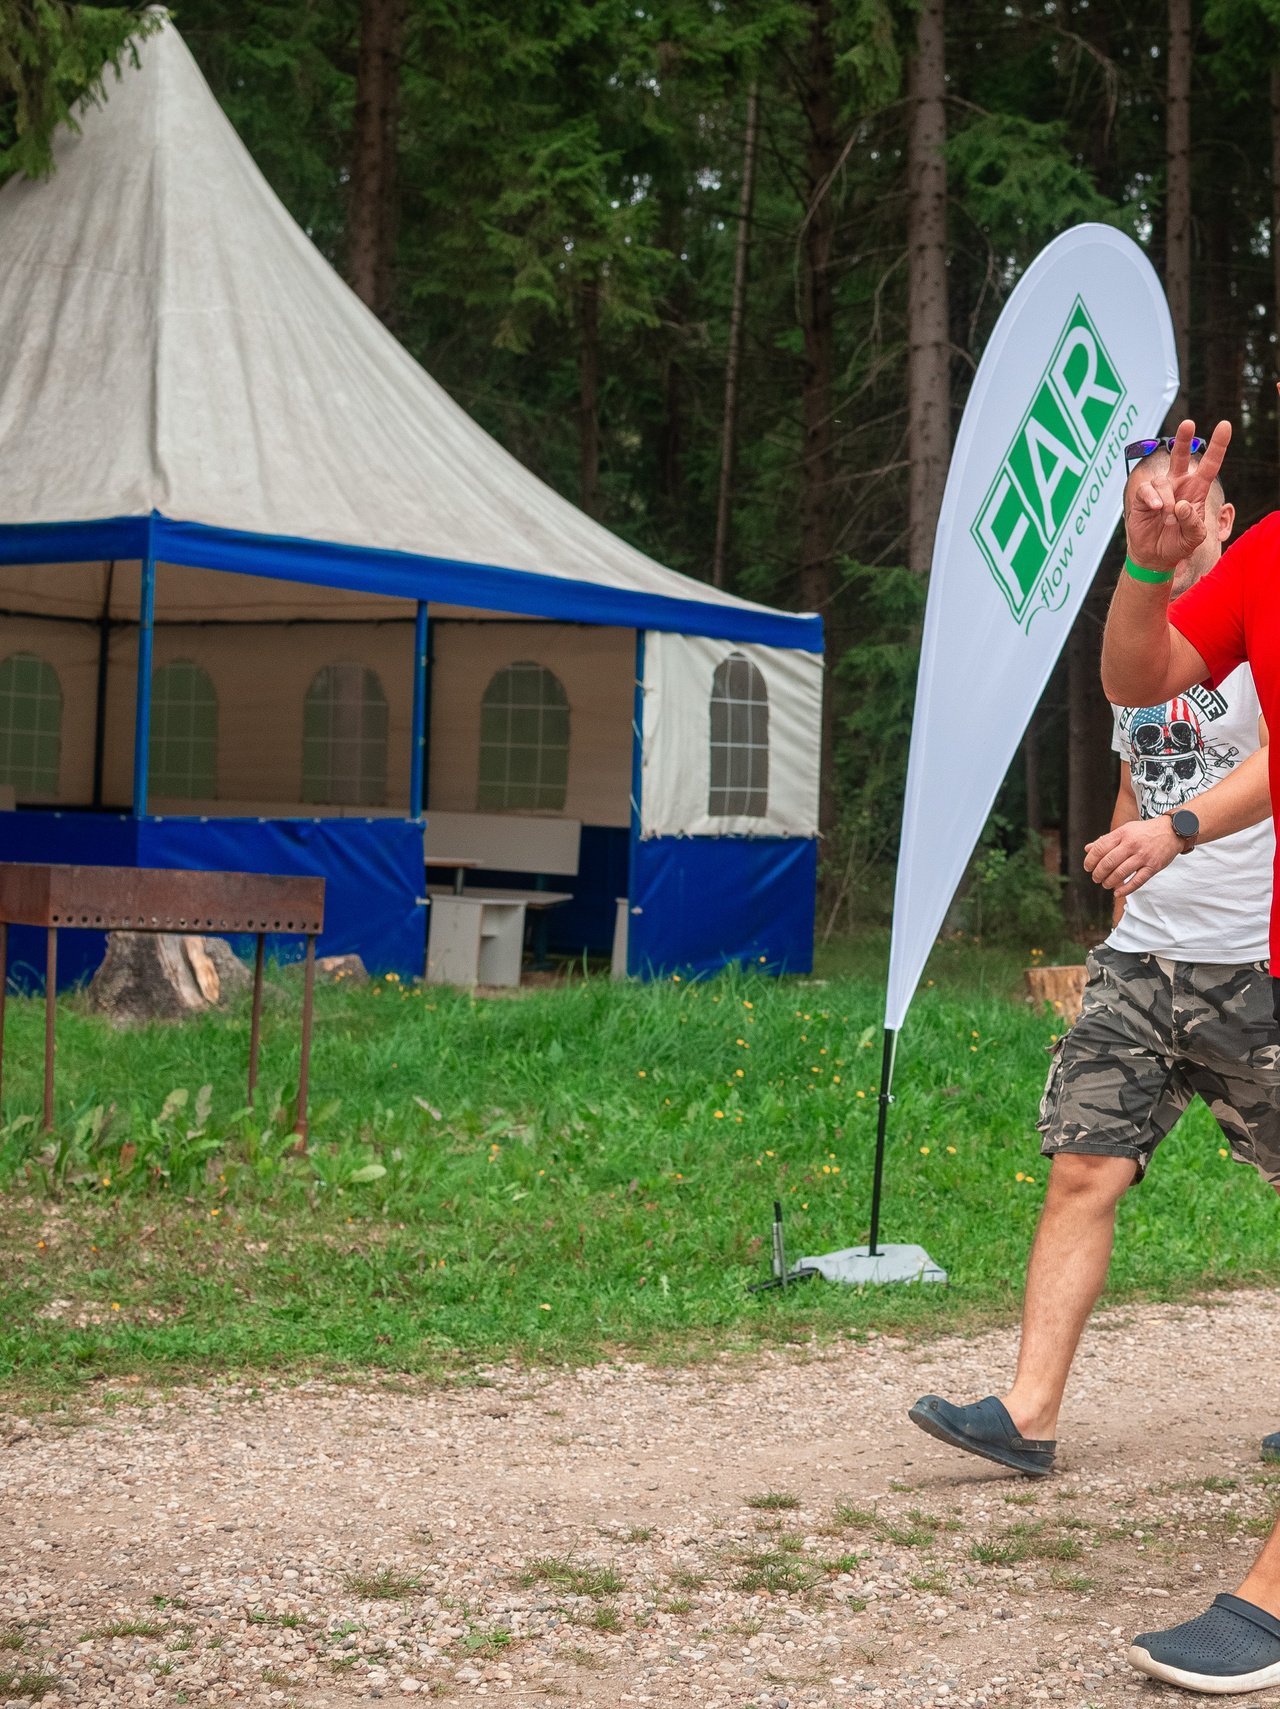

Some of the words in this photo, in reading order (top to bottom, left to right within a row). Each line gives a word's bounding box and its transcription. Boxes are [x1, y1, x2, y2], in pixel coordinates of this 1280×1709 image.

[977, 325, 1120, 598] FAR
[1040, 537, 1074, 609] flow
[1075, 404, 1139, 536] evolution
